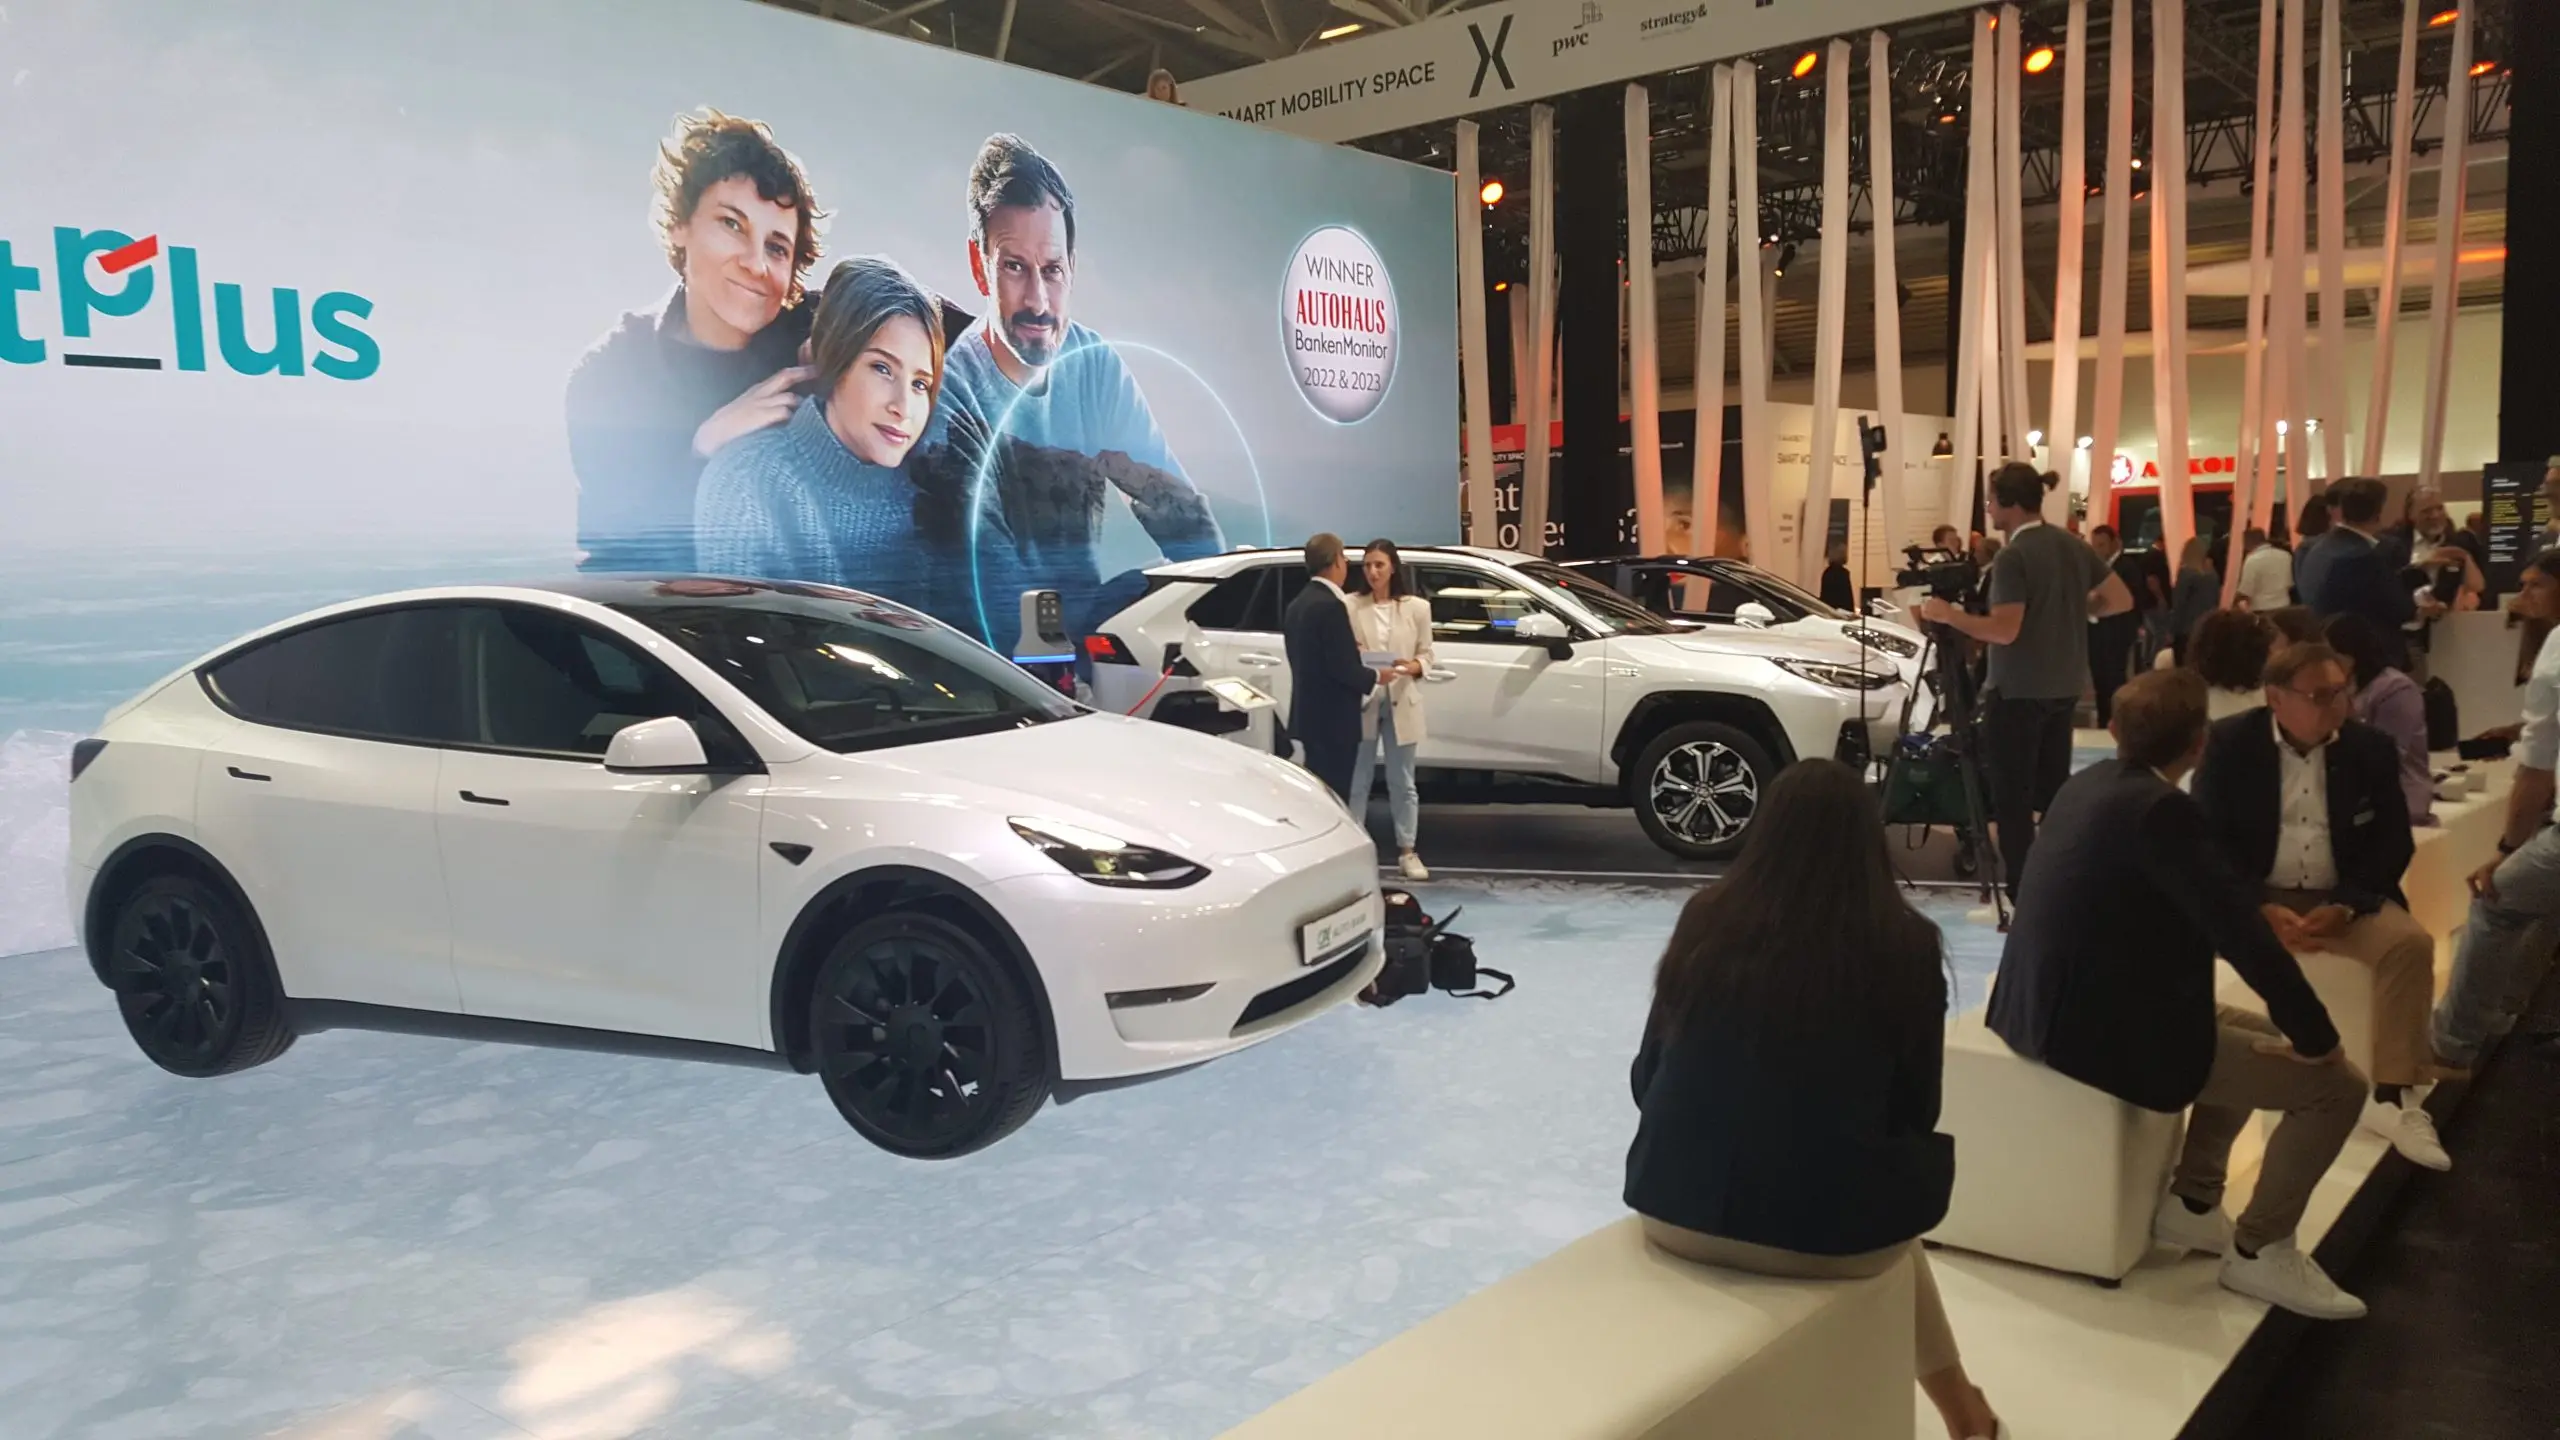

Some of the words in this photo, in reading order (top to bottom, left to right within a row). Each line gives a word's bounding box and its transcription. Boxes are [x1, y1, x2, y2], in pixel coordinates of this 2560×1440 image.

[1640, 3, 1707, 32] strategy&
[1551, 31, 1589, 57] pwc
[1281, 76, 1368, 116] MOBILITY
[1373, 62, 1435, 94] SPACE
[1305, 253, 1374, 288] WINNER
[1296, 288, 1386, 334] AUTOHAUS
[1295, 329, 1388, 360] BankenMonitor
[1304, 366, 1336, 388] 2022
[1338, 369, 1349, 389] &
[1351, 371, 1381, 391] 2023
